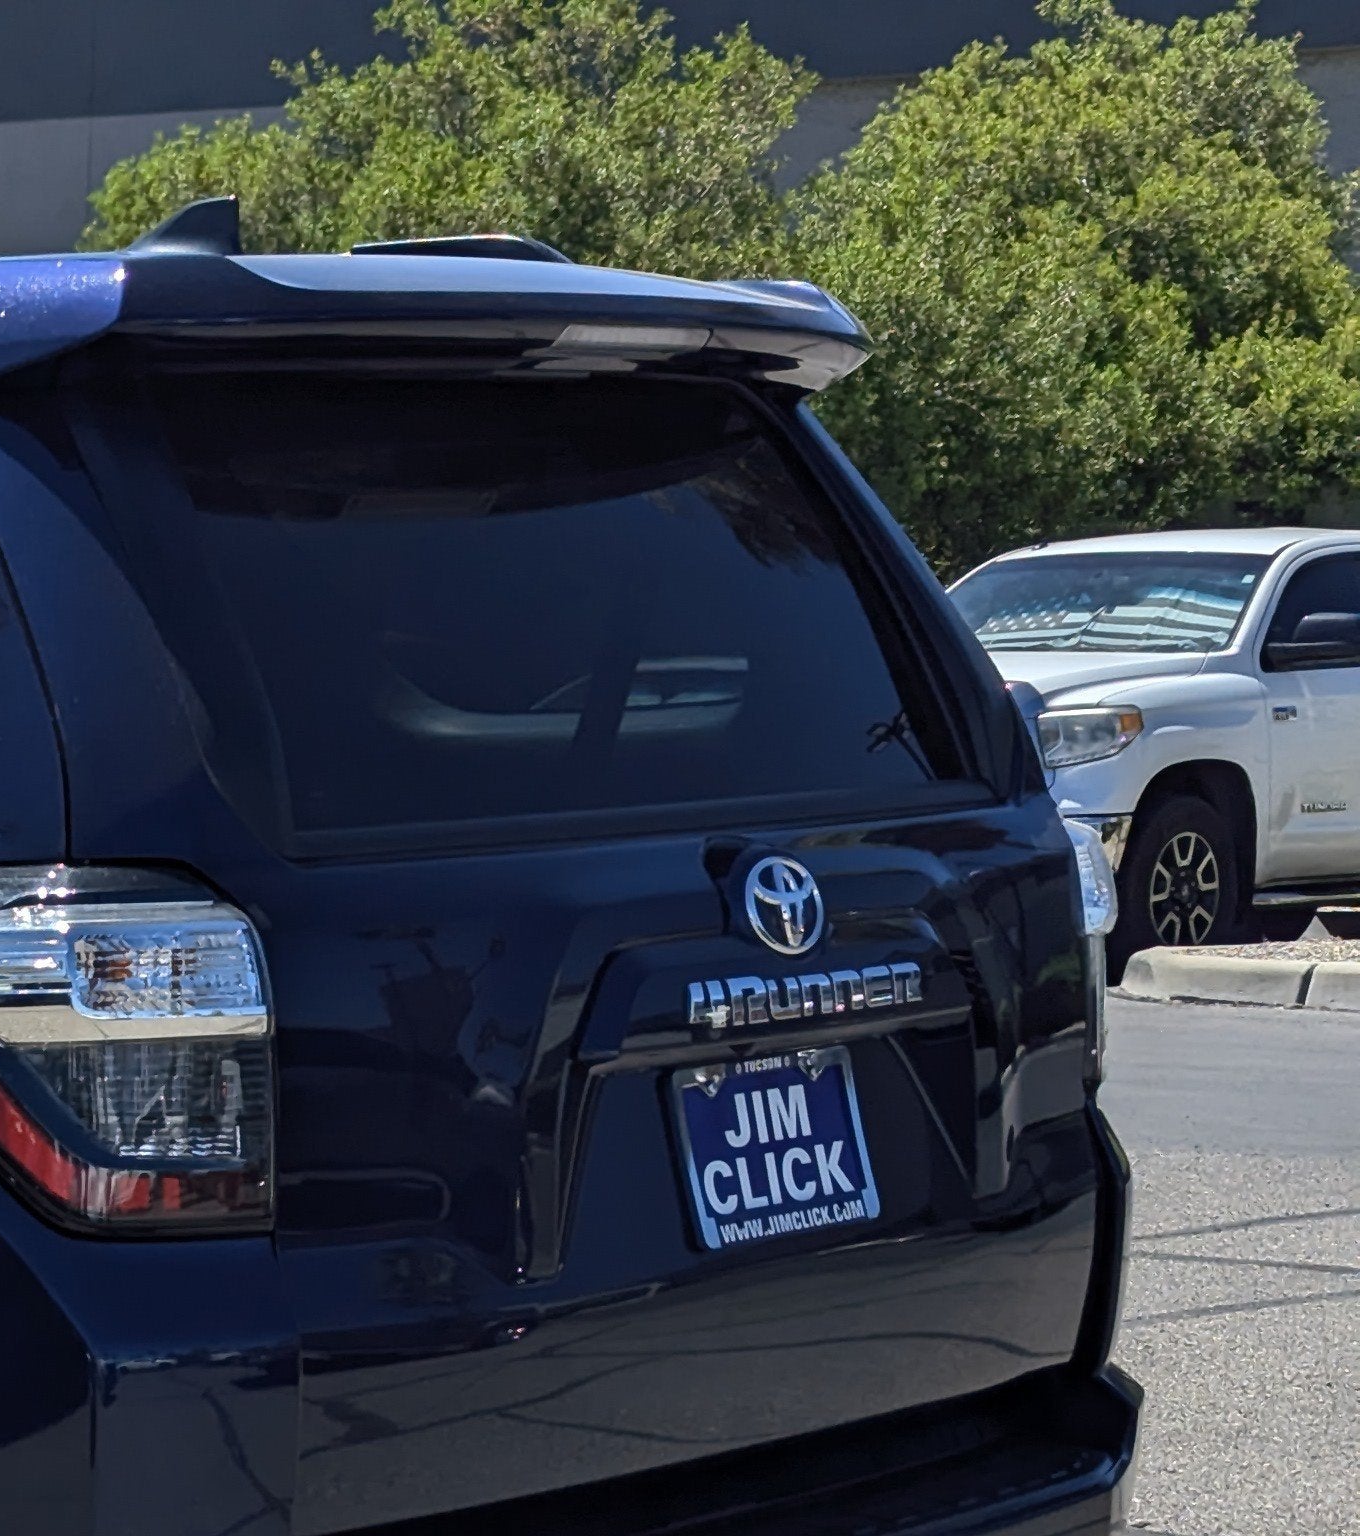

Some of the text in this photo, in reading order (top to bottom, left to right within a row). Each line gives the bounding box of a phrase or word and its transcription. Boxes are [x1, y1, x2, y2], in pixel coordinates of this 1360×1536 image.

[744, 1056, 783, 1073] TUCSON
[724, 1083, 813, 1148] JIM
[703, 1140, 856, 1216] CLICK
[720, 1199, 866, 1244] WWW.JIMCLICK.COM
